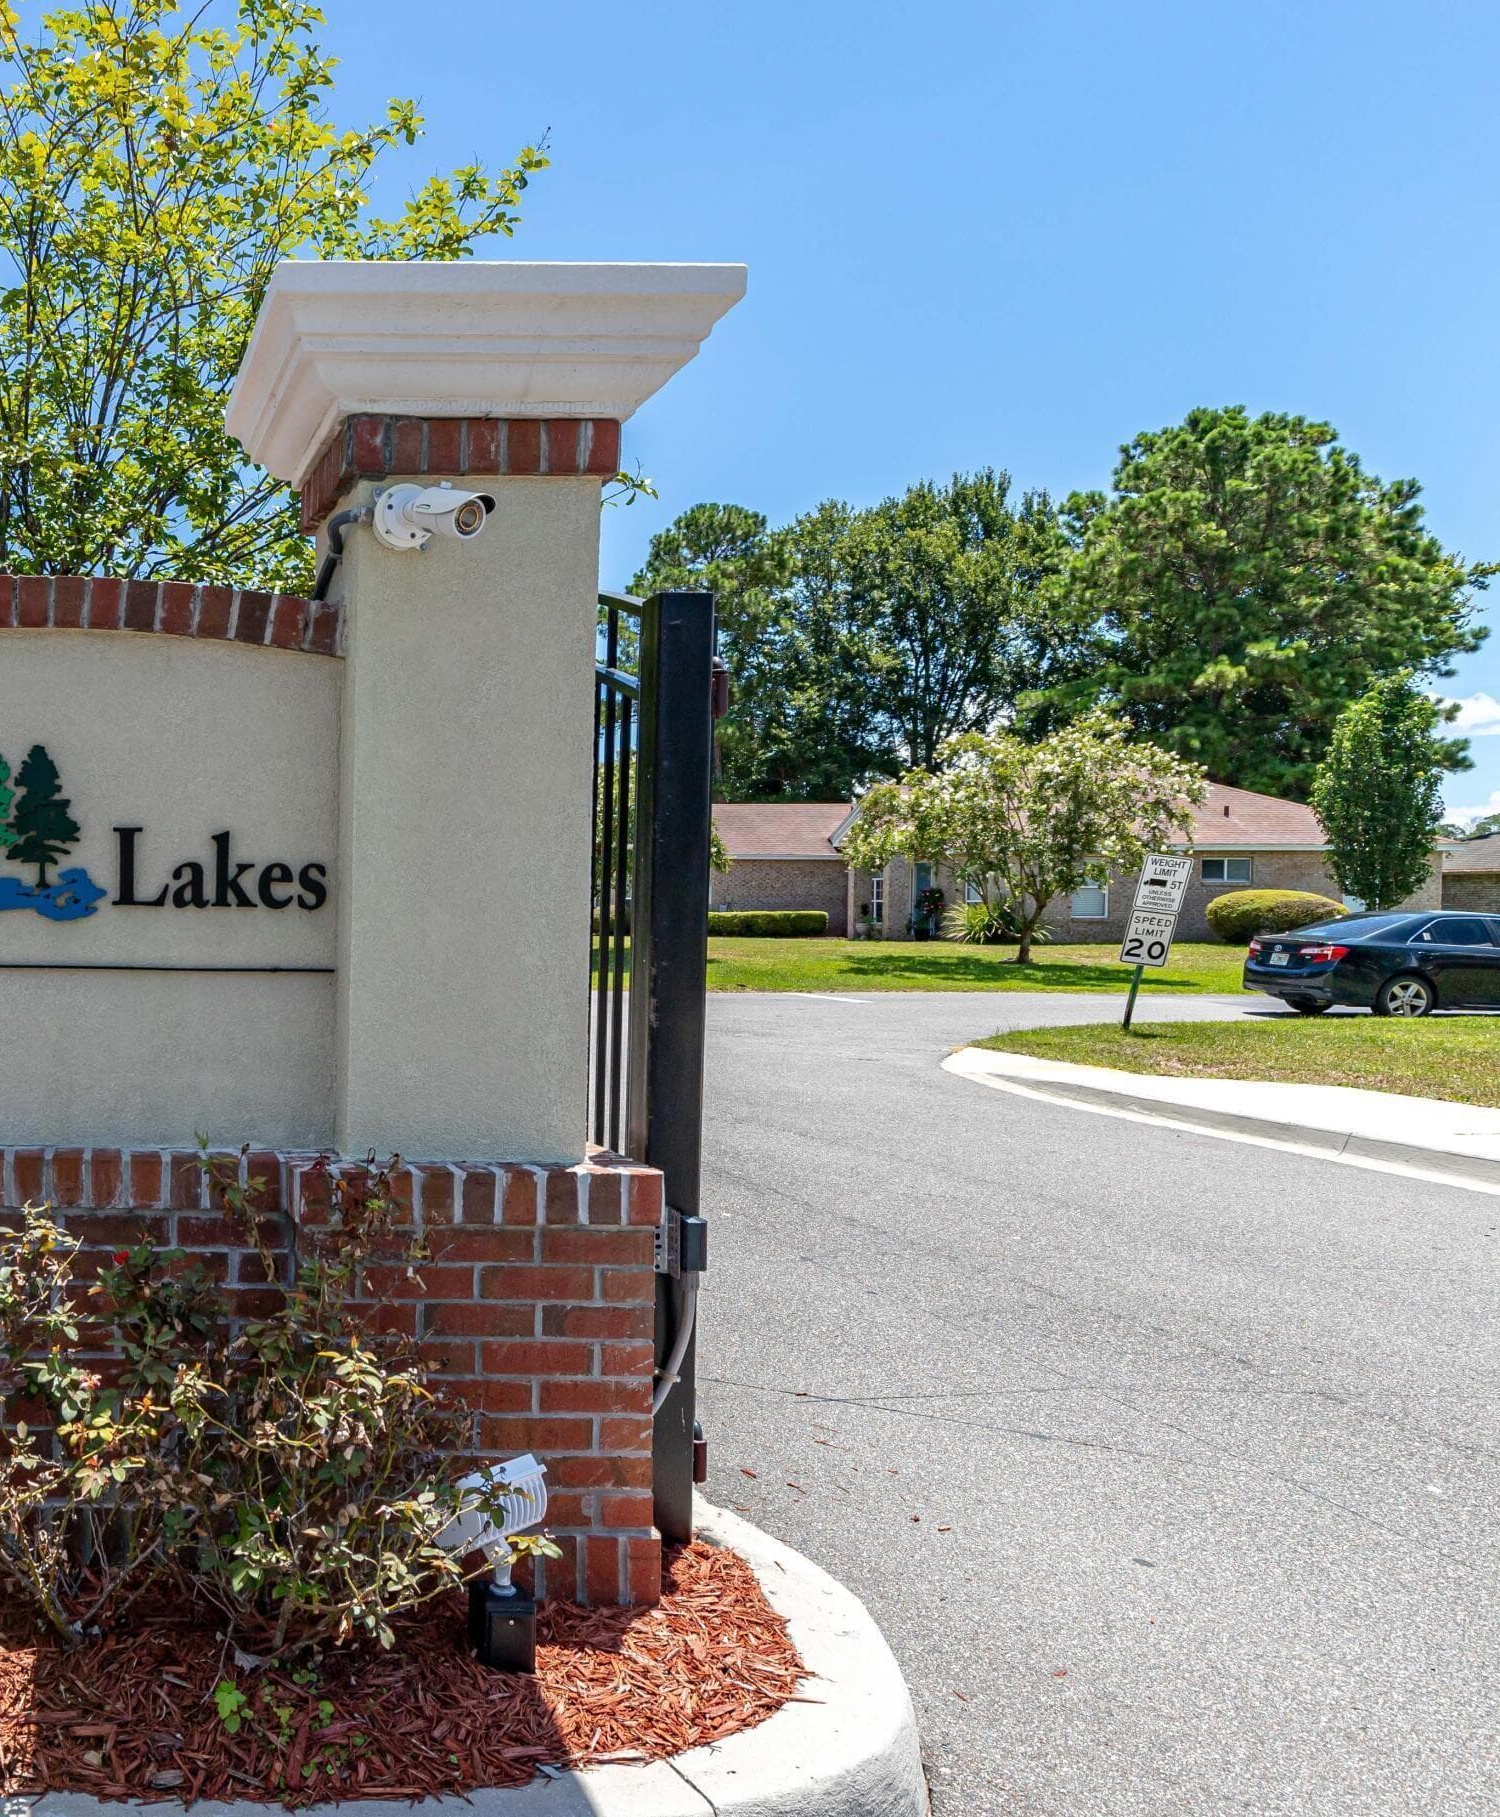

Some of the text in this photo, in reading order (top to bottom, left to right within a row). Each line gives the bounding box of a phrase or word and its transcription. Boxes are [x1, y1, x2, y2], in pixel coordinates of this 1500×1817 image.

[112, 826, 328, 911] Lakes
[1150, 857, 1188, 869] WEIGHT
[1153, 867, 1178, 877] LIMIT
[1170, 880, 1184, 890] 5T
[1141, 894, 1176, 904] OTHERWISE
[1141, 900, 1173, 909] APPROVED
[1133, 915, 1172, 928] SPEED
[1134, 927, 1165, 938] LIMIT
[1124, 938, 1165, 960] 20
